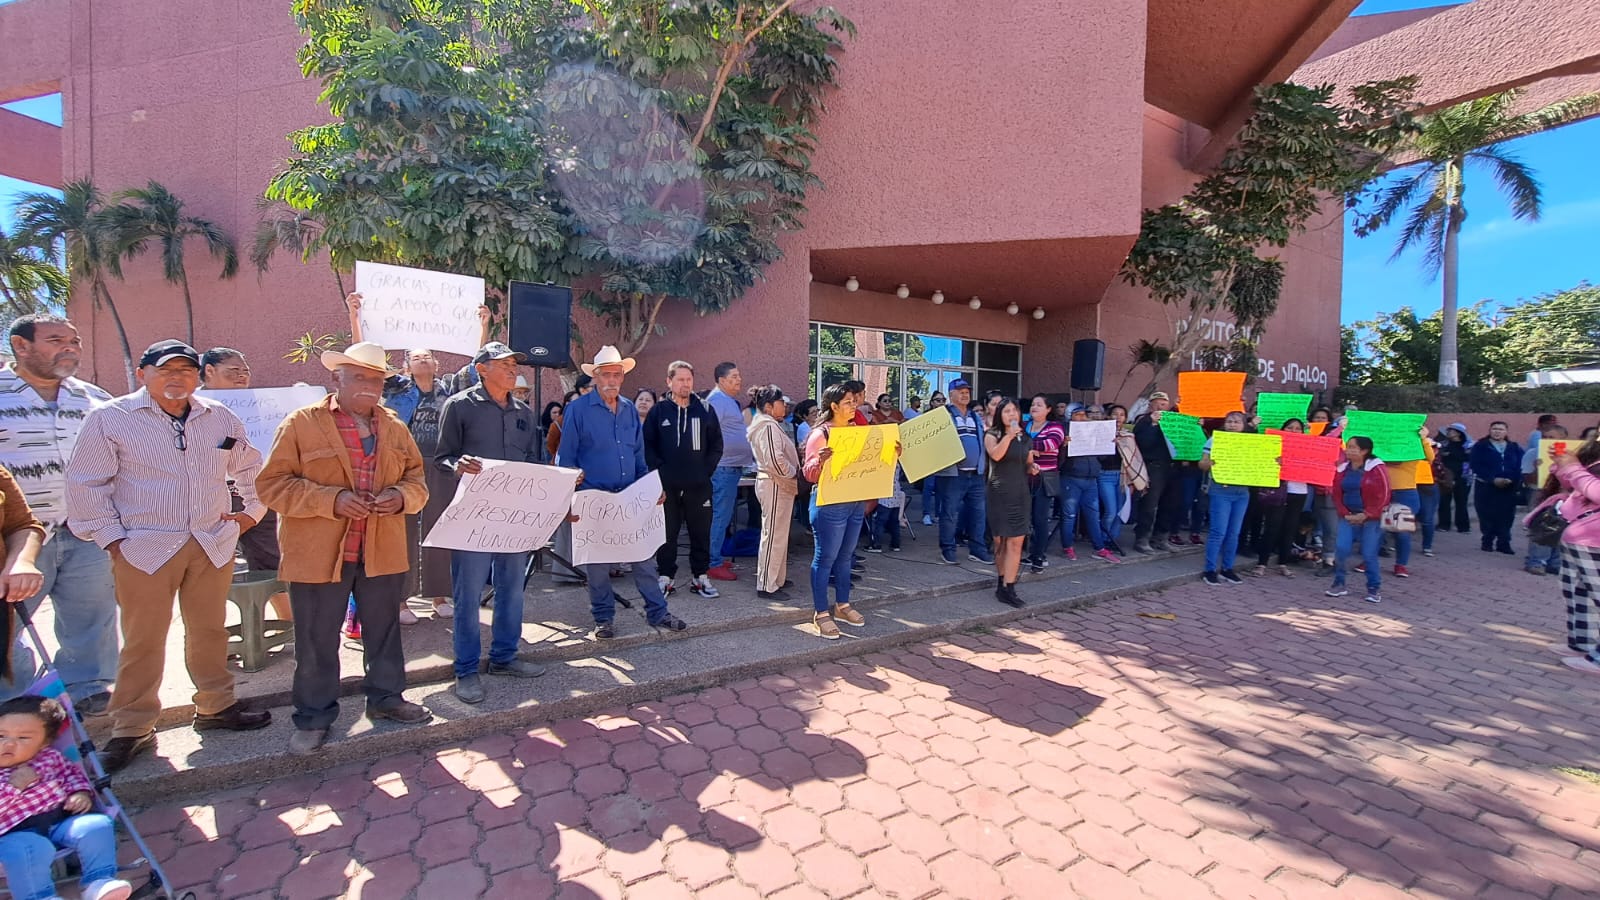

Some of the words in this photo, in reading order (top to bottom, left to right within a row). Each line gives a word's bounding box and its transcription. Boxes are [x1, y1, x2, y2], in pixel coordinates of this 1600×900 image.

[369, 271, 432, 294] GRACIAS
[440, 280, 465, 300] POR
[361, 296, 382, 311] EL
[390, 296, 442, 316] APOYO
[1257, 357, 1276, 382] DE
[466, 498, 562, 529] PRESIDENTE
